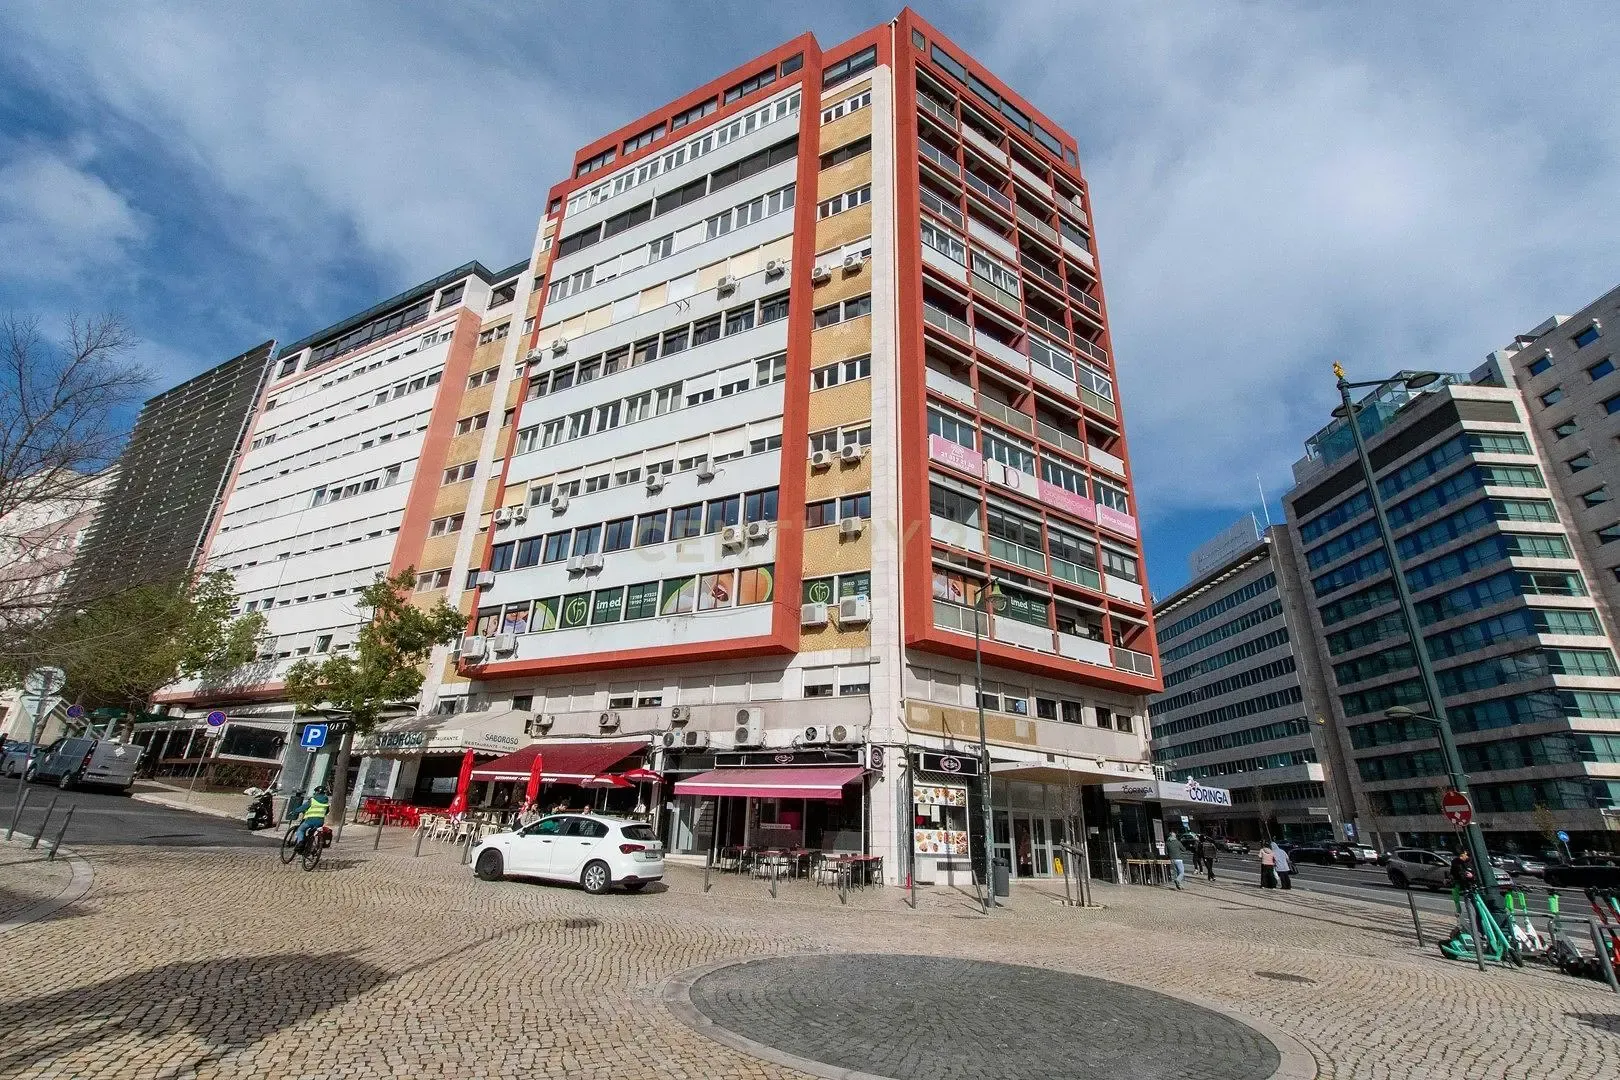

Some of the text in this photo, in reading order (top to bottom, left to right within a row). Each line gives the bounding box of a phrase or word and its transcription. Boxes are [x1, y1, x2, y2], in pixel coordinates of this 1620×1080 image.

[306, 728, 322, 743] P
[376, 731, 423, 747] SABOROSO
[485, 733, 520, 746] SABOROSO
[1123, 786, 1154, 795] CORINGA
[1189, 787, 1229, 804] CORINGA
